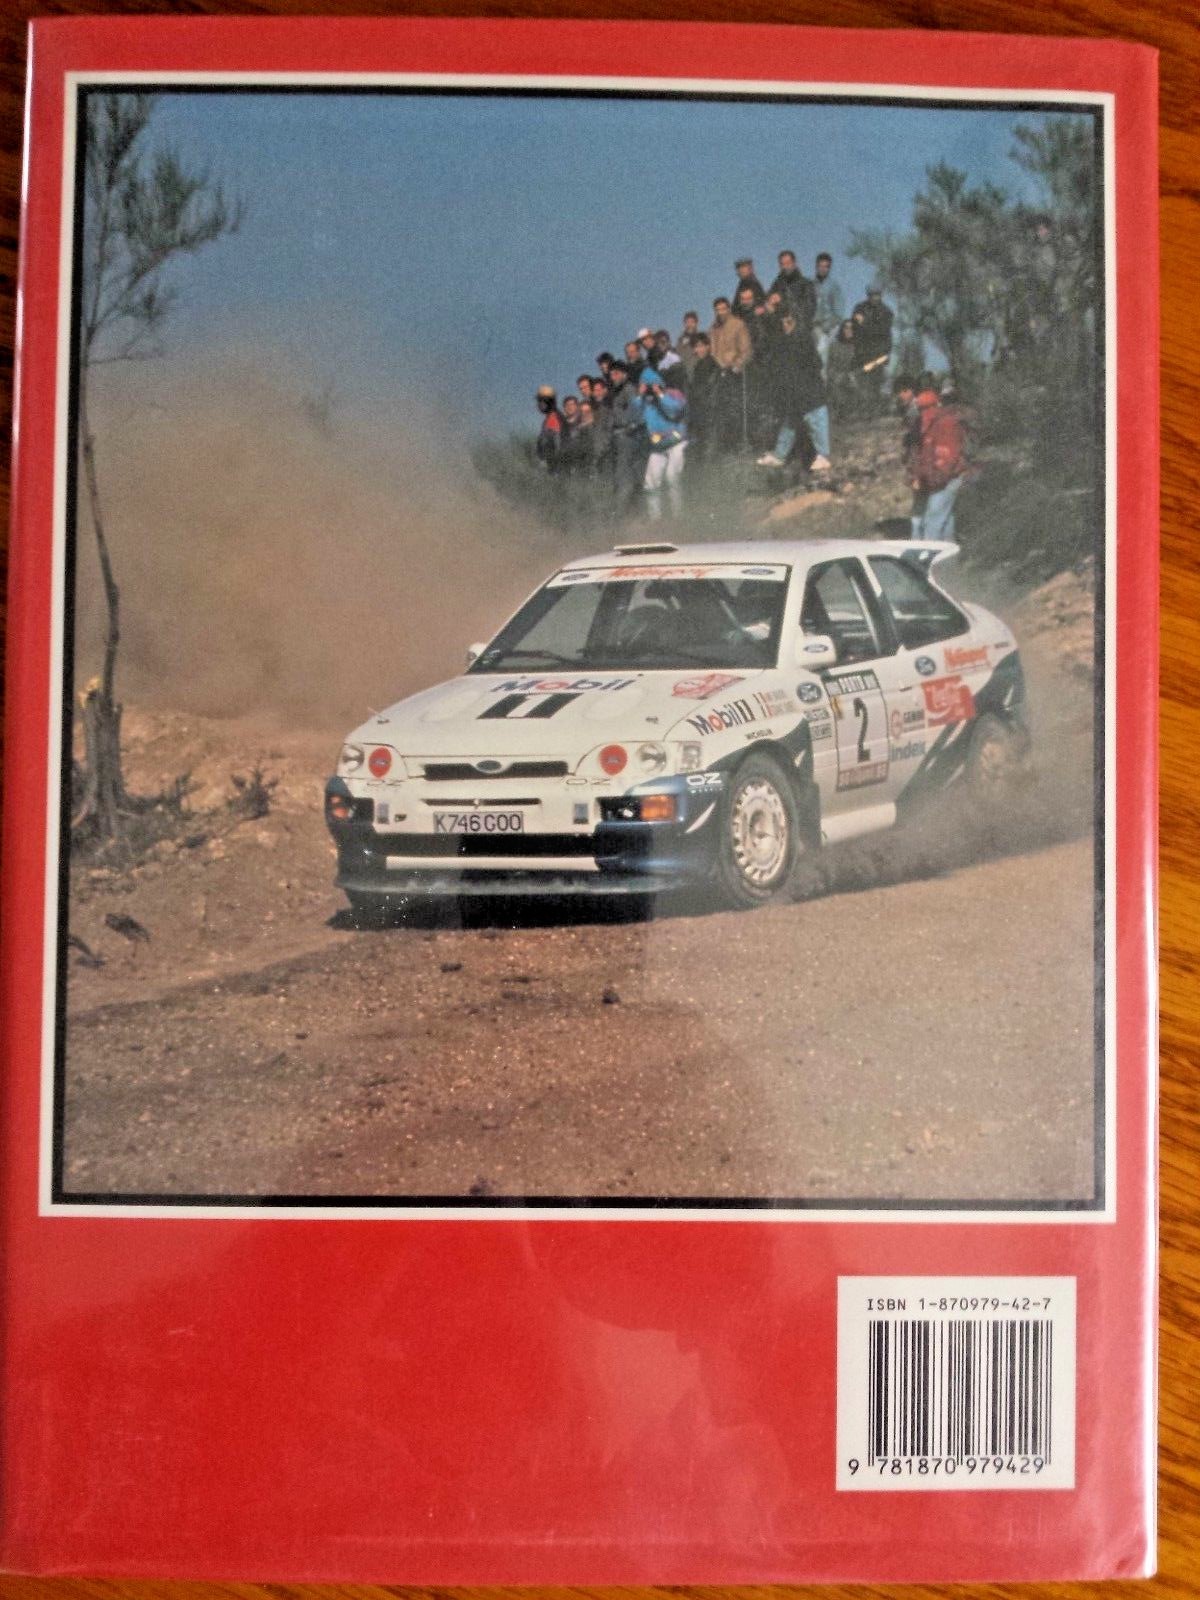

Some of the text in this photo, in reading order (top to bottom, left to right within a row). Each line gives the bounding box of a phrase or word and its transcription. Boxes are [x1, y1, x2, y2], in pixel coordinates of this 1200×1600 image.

[490, 679, 636, 693] Mobil
[686, 702, 742, 736] Mobil
[853, 697, 871, 762] 2
[686, 772, 722, 786] OZ
[434, 813, 522, 833] K746 GOO
[867, 1297, 1052, 1311] ISBN 1-870979-42-7
[848, 1457, 1045, 1475] 9 781870 979429
